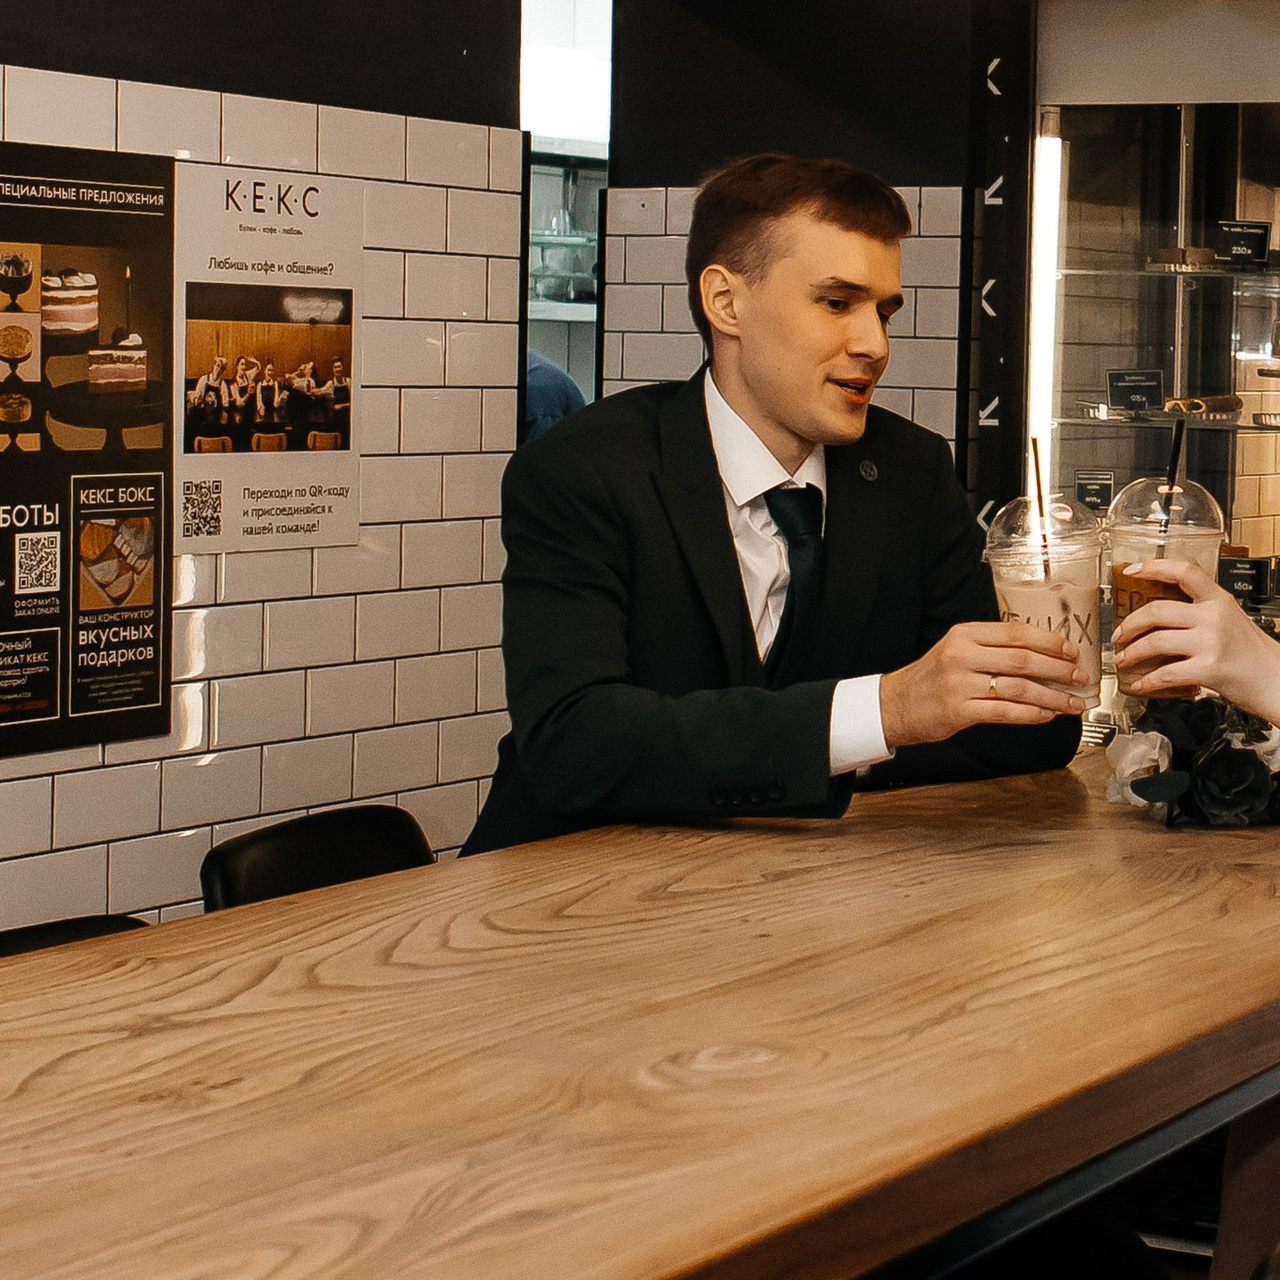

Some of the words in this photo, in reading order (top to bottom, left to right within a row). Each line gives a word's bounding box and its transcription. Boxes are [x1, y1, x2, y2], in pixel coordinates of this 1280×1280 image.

[79, 188, 164, 206] ПРЕДЛОЖЕНИЯ
[208, 257, 249, 271] Любишь
[251, 260, 276, 276] кофе
[286, 262, 334, 276] общение?
[80, 489, 115, 504] КЕКС
[118, 487, 155, 503] БОКС
[243, 487, 293, 502] Переходи
[294, 488, 307, 498] по
[309, 485, 350, 498] QR-коду
[242, 509, 249, 517] и
[251, 503, 326, 520] присоединяйся
[327, 505, 333, 514] к
[242, 523, 274, 536] нашей
[275, 520, 320, 534] команде!
[78, 646, 154, 667] подарков
